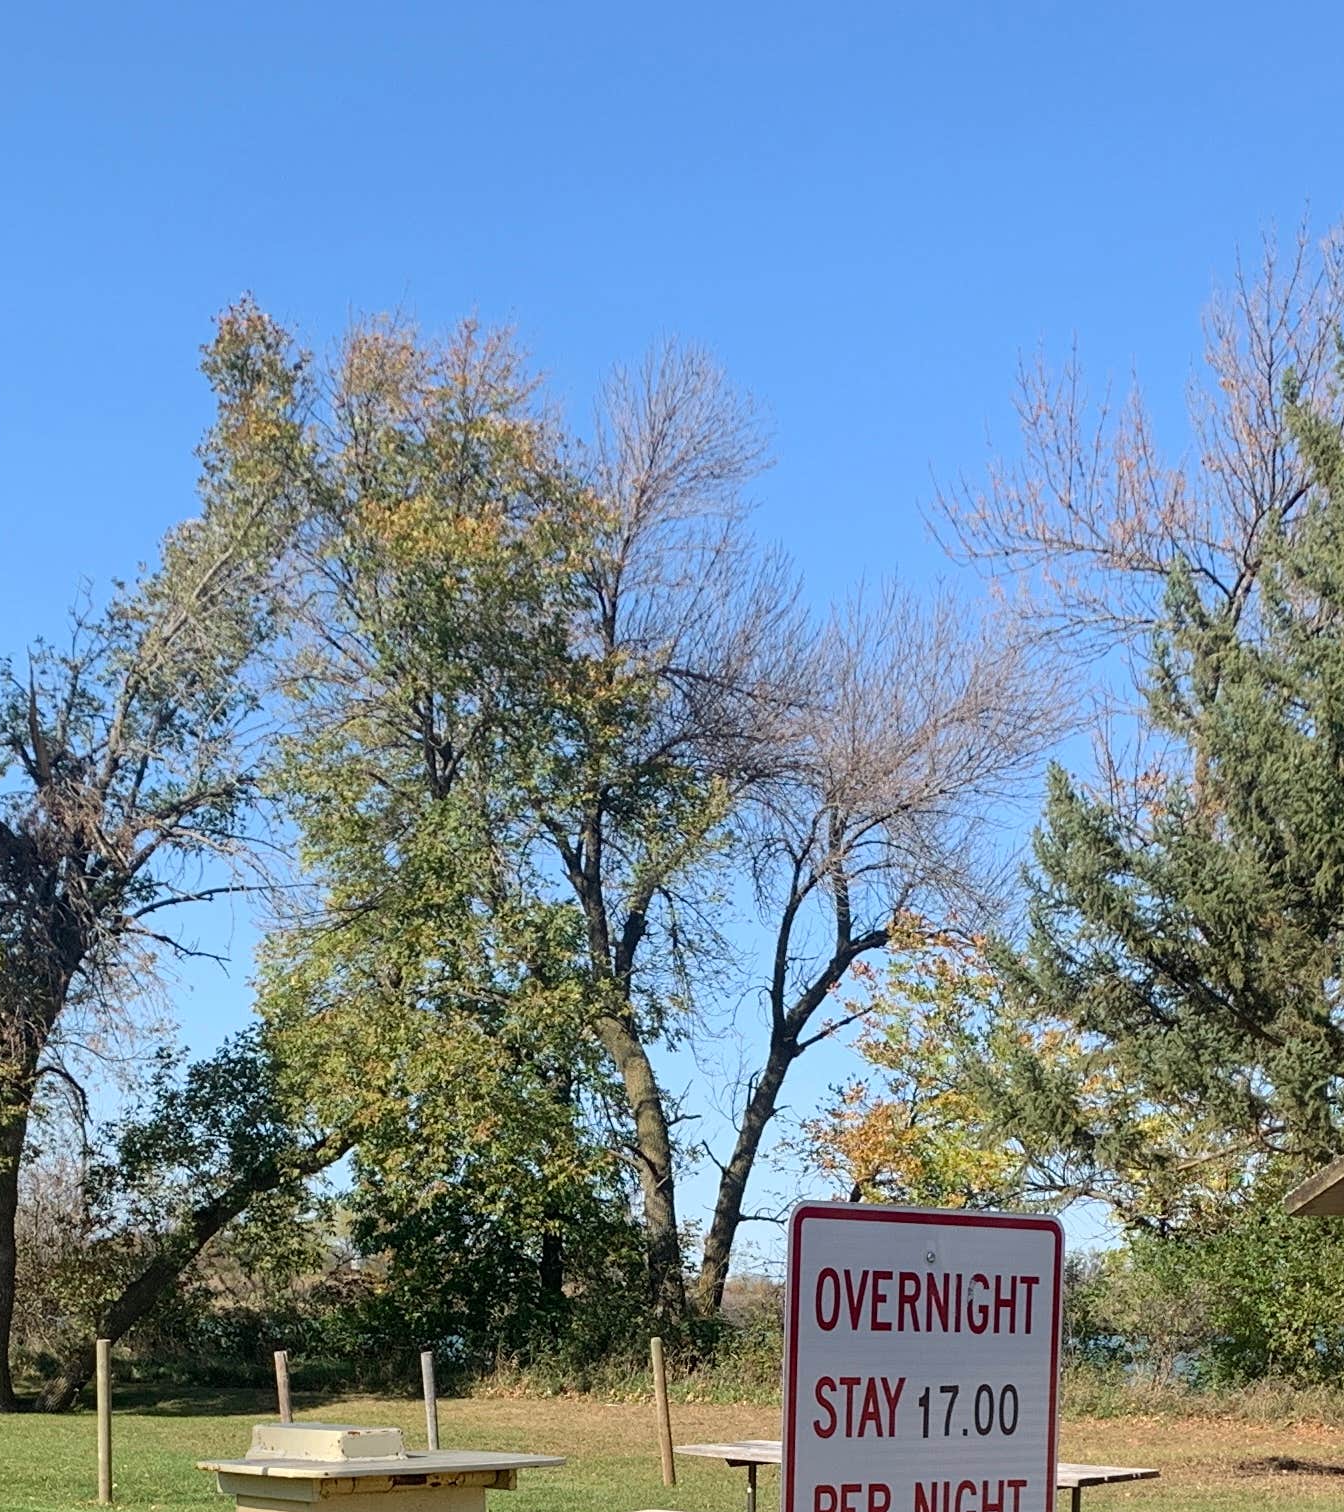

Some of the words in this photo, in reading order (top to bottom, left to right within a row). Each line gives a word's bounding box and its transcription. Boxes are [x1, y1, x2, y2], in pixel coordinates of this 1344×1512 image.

[815, 1267, 1040, 1334] OVERNIGHT
[813, 1376, 906, 1438] STAY
[918, 1383, 1019, 1438] 17.00
